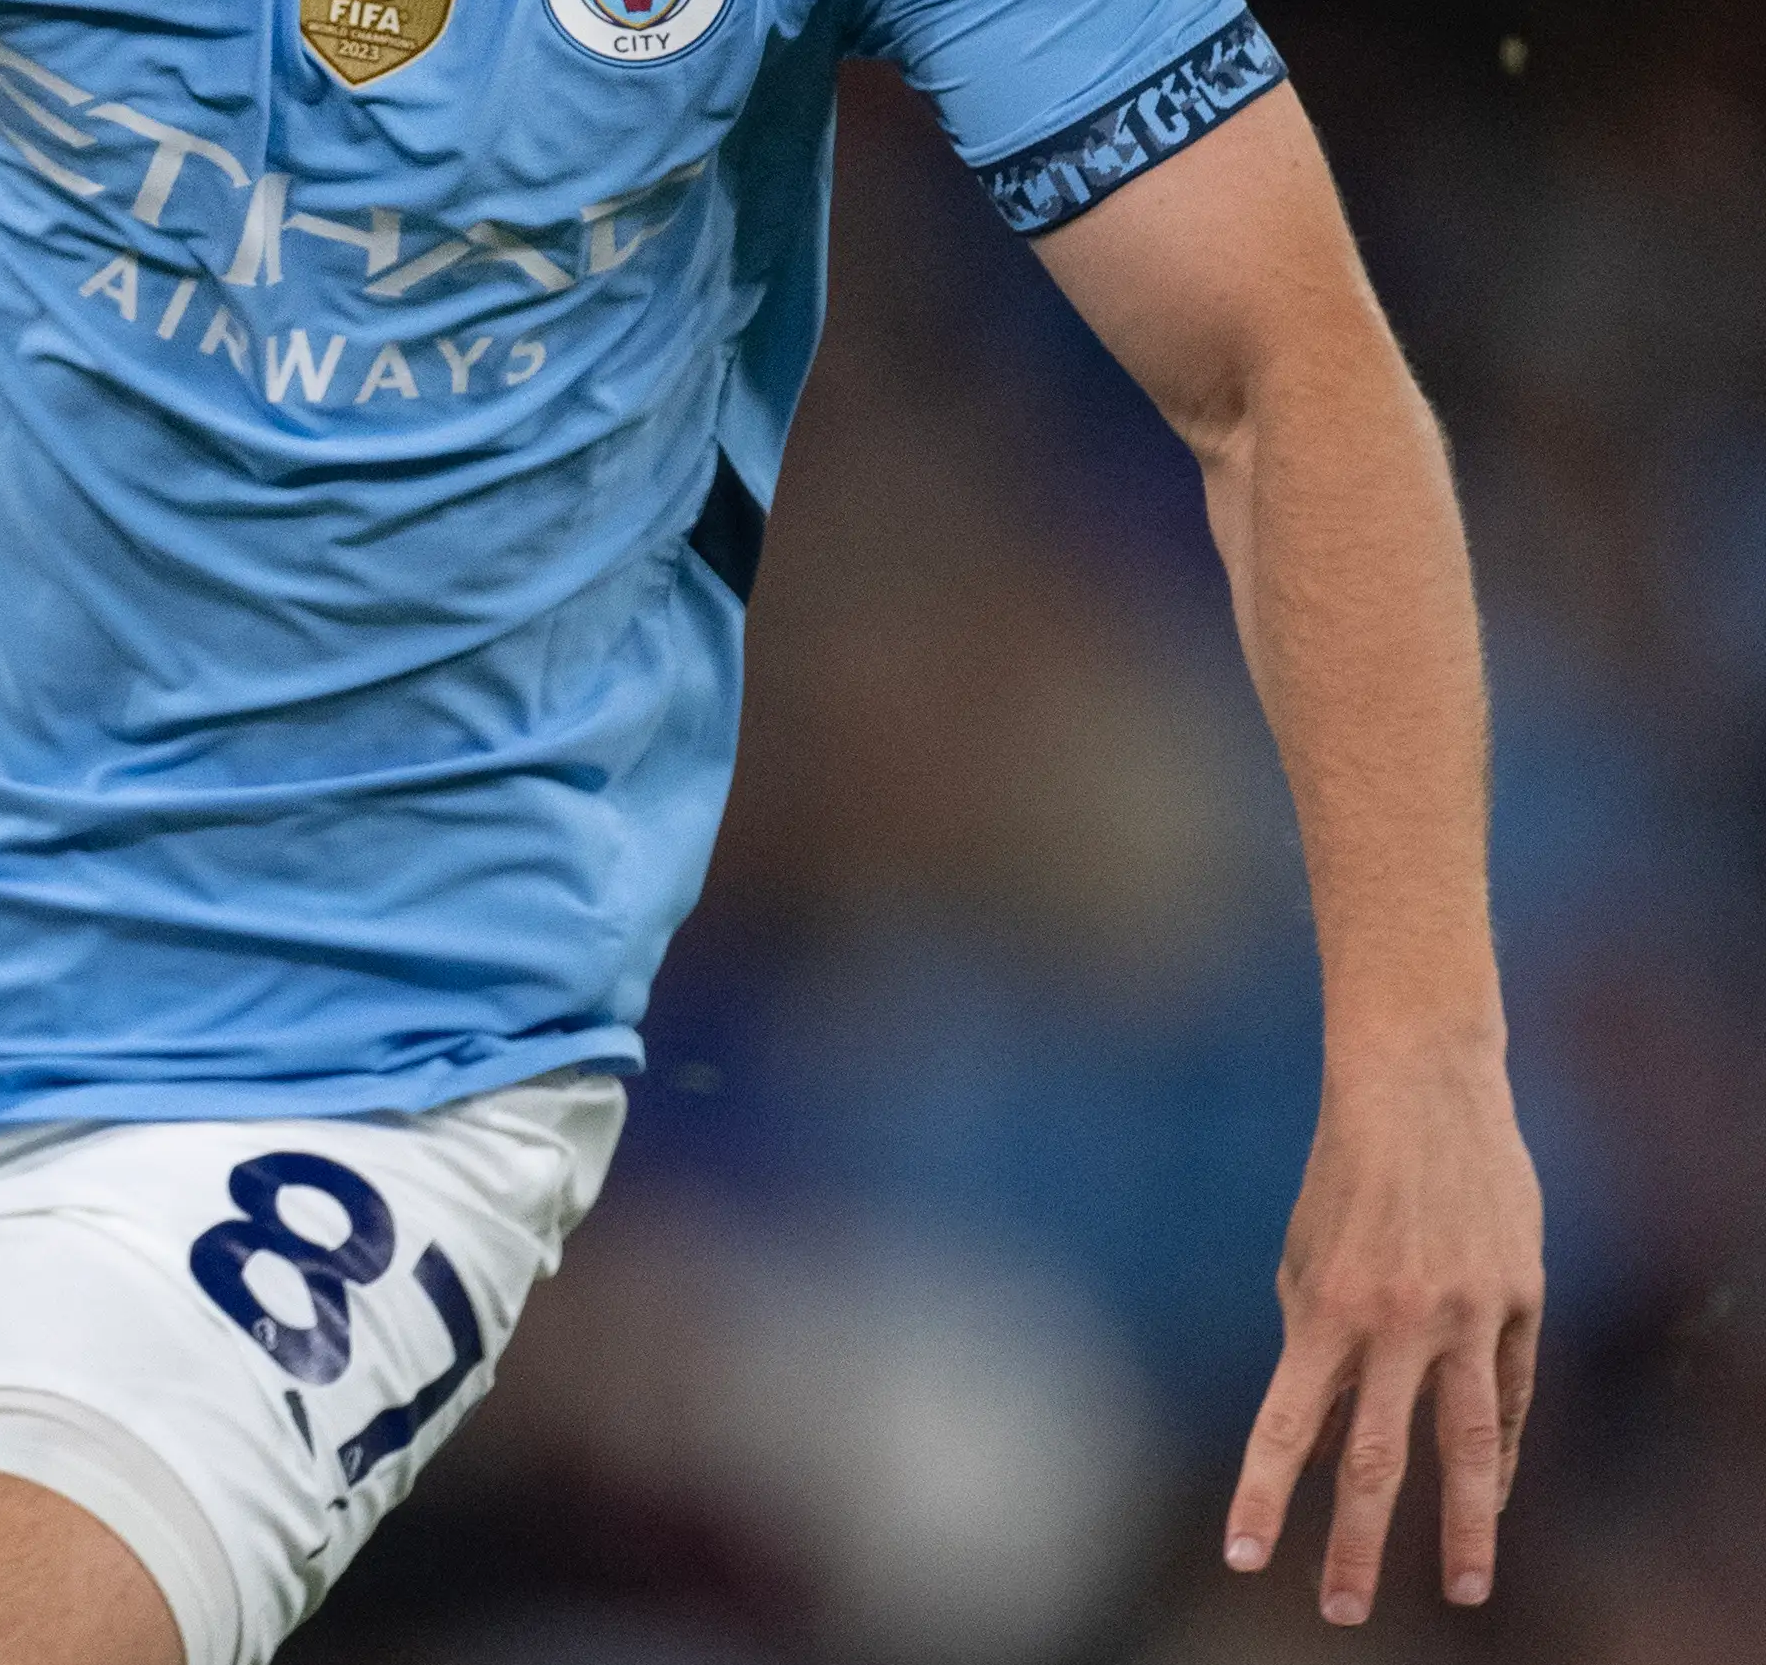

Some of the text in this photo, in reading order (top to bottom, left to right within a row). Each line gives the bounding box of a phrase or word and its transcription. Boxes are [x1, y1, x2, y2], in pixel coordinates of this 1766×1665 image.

[338, 39, 380, 61] 2023
[614, 33, 671, 53] CITY
[189, 1151, 485, 1487] 87
